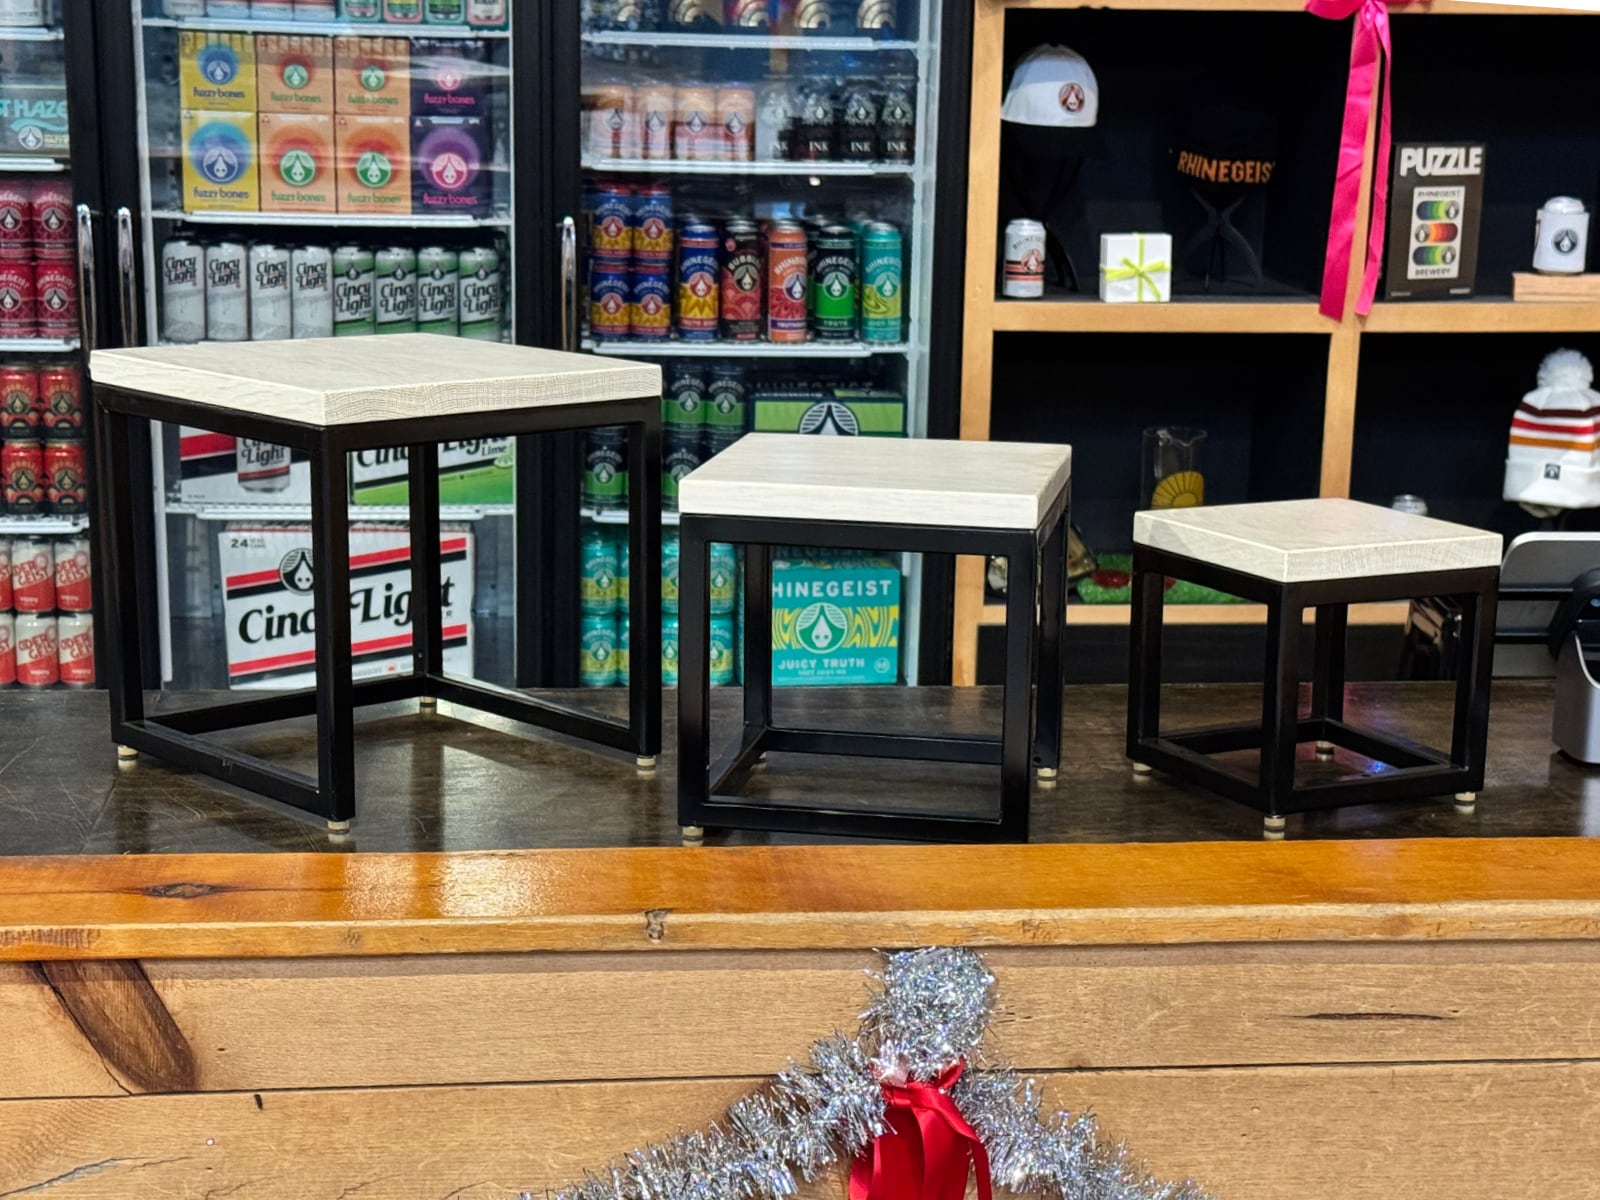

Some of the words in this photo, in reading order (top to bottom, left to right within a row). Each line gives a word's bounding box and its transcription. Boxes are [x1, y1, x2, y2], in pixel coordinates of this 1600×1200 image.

[193, 87, 217, 98] fuzzy
[218, 88, 245, 98] bones
[424, 92, 447, 104] fuzzy
[448, 94, 475, 105] bones
[0, 98, 10, 118] T
[770, 140, 789, 152] NK
[809, 140, 829, 152] INK
[851, 140, 871, 152] INK
[887, 140, 907, 152] INK
[1177, 150, 1275, 184] RHINEGEIS
[1400, 147, 1483, 176] PUZZLE
[193, 186, 218, 199] fuzzy
[219, 187, 249, 200] bones
[424, 192, 447, 204] fuzzy
[448, 193, 478, 204] bones
[165, 256, 197, 271] Cincy
[209, 258, 240, 273] Cincy
[256, 260, 288, 275] Cincy
[296, 262, 327, 276] Cincy
[728, 254, 762, 271] BUBBL
[165, 268, 197, 284] Light
[209, 270, 240, 287] Light
[255, 272, 288, 288] Light
[295, 273, 327, 289] Light
[336, 281, 370, 298] Cincy
[381, 282, 415, 299] Cinc
[464, 282, 498, 299] Cinc
[335, 295, 371, 316] Light
[380, 297, 416, 316] Ligh
[463, 297, 499, 316] Ligh
[241, 445, 285, 466] Light
[481, 443, 507, 457] Lime
[231, 538, 248, 549] 24
[771, 579, 892, 599] HINEGEIST
[238, 604, 315, 645] Cinc
[350, 575, 456, 627] Ligt
[778, 658, 817, 670] JUICY
[822, 657, 865, 668] TRUTH
